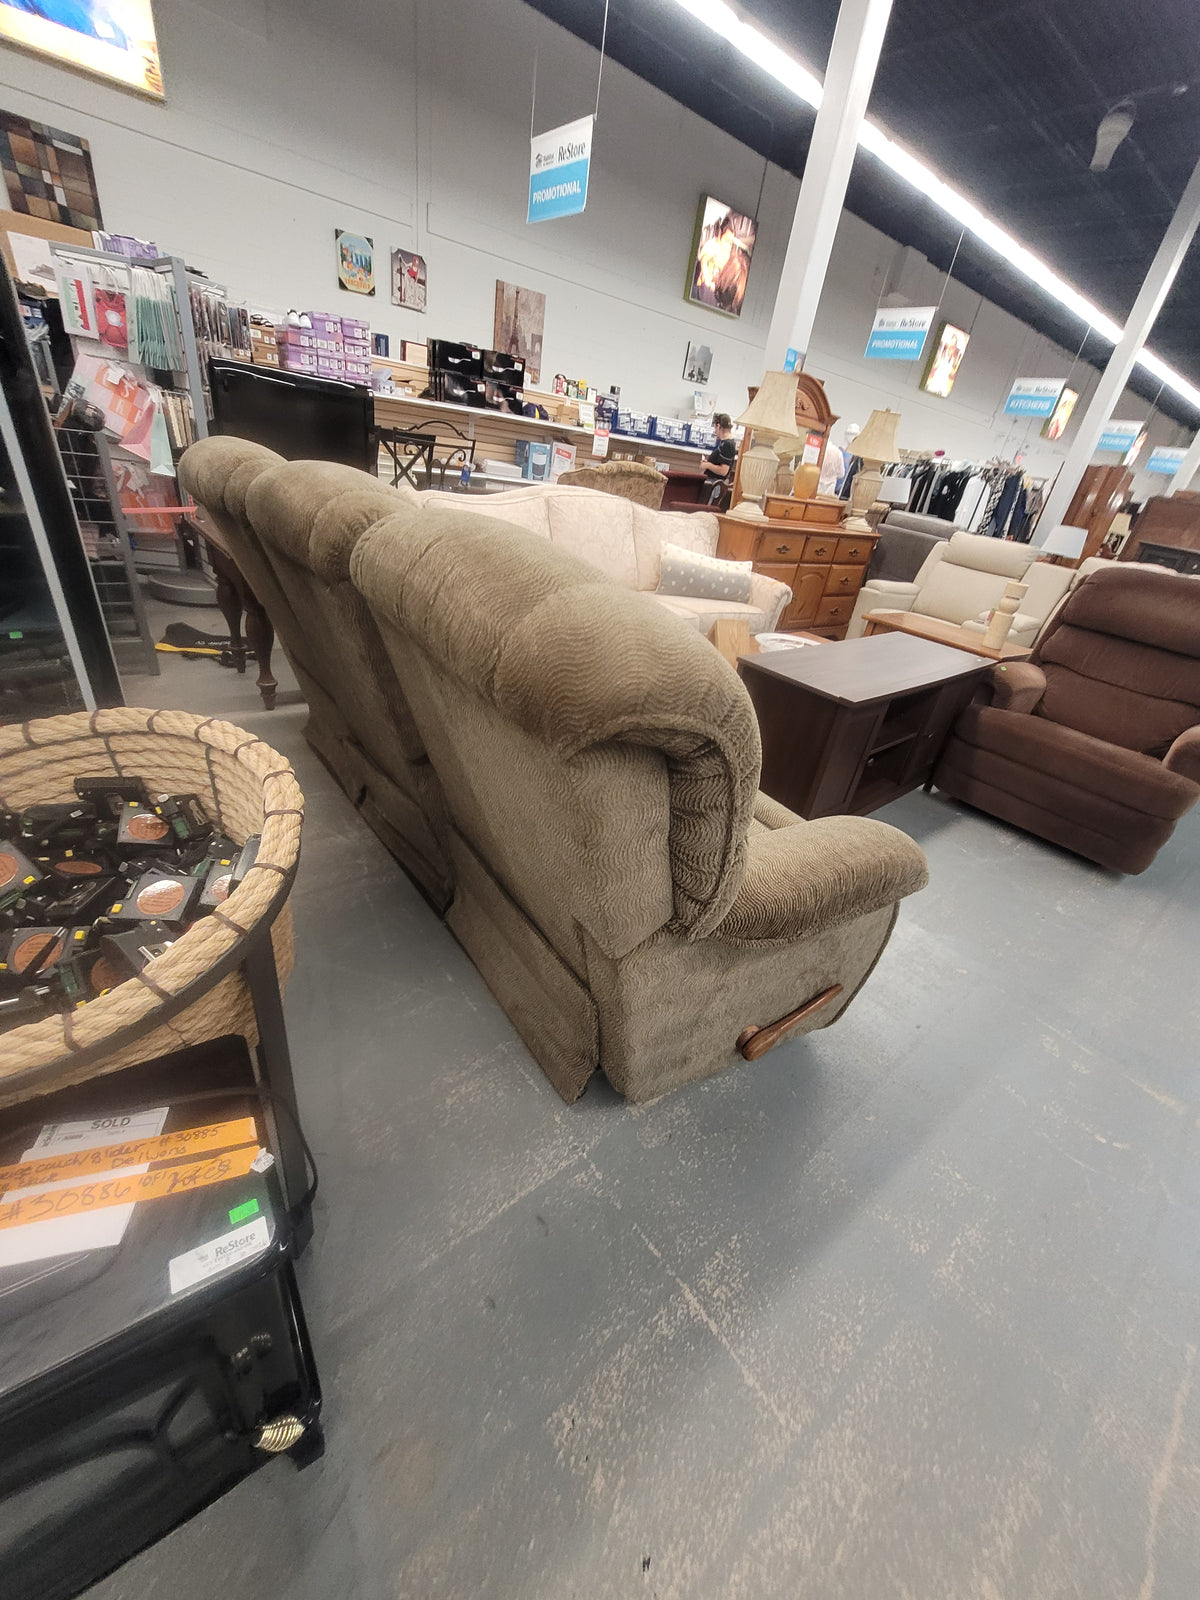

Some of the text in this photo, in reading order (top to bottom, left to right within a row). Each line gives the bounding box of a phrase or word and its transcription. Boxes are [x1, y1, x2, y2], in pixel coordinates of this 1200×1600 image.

[557, 142, 586, 162] ReStore
[532, 180, 581, 205] PROMOTIONAL
[871, 339, 918, 349] PROMOTIONAL
[1009, 399, 1051, 410] KITCHENS
[91, 1117, 131, 1129] SOLD
[215, 1232, 256, 1257] ReStore
